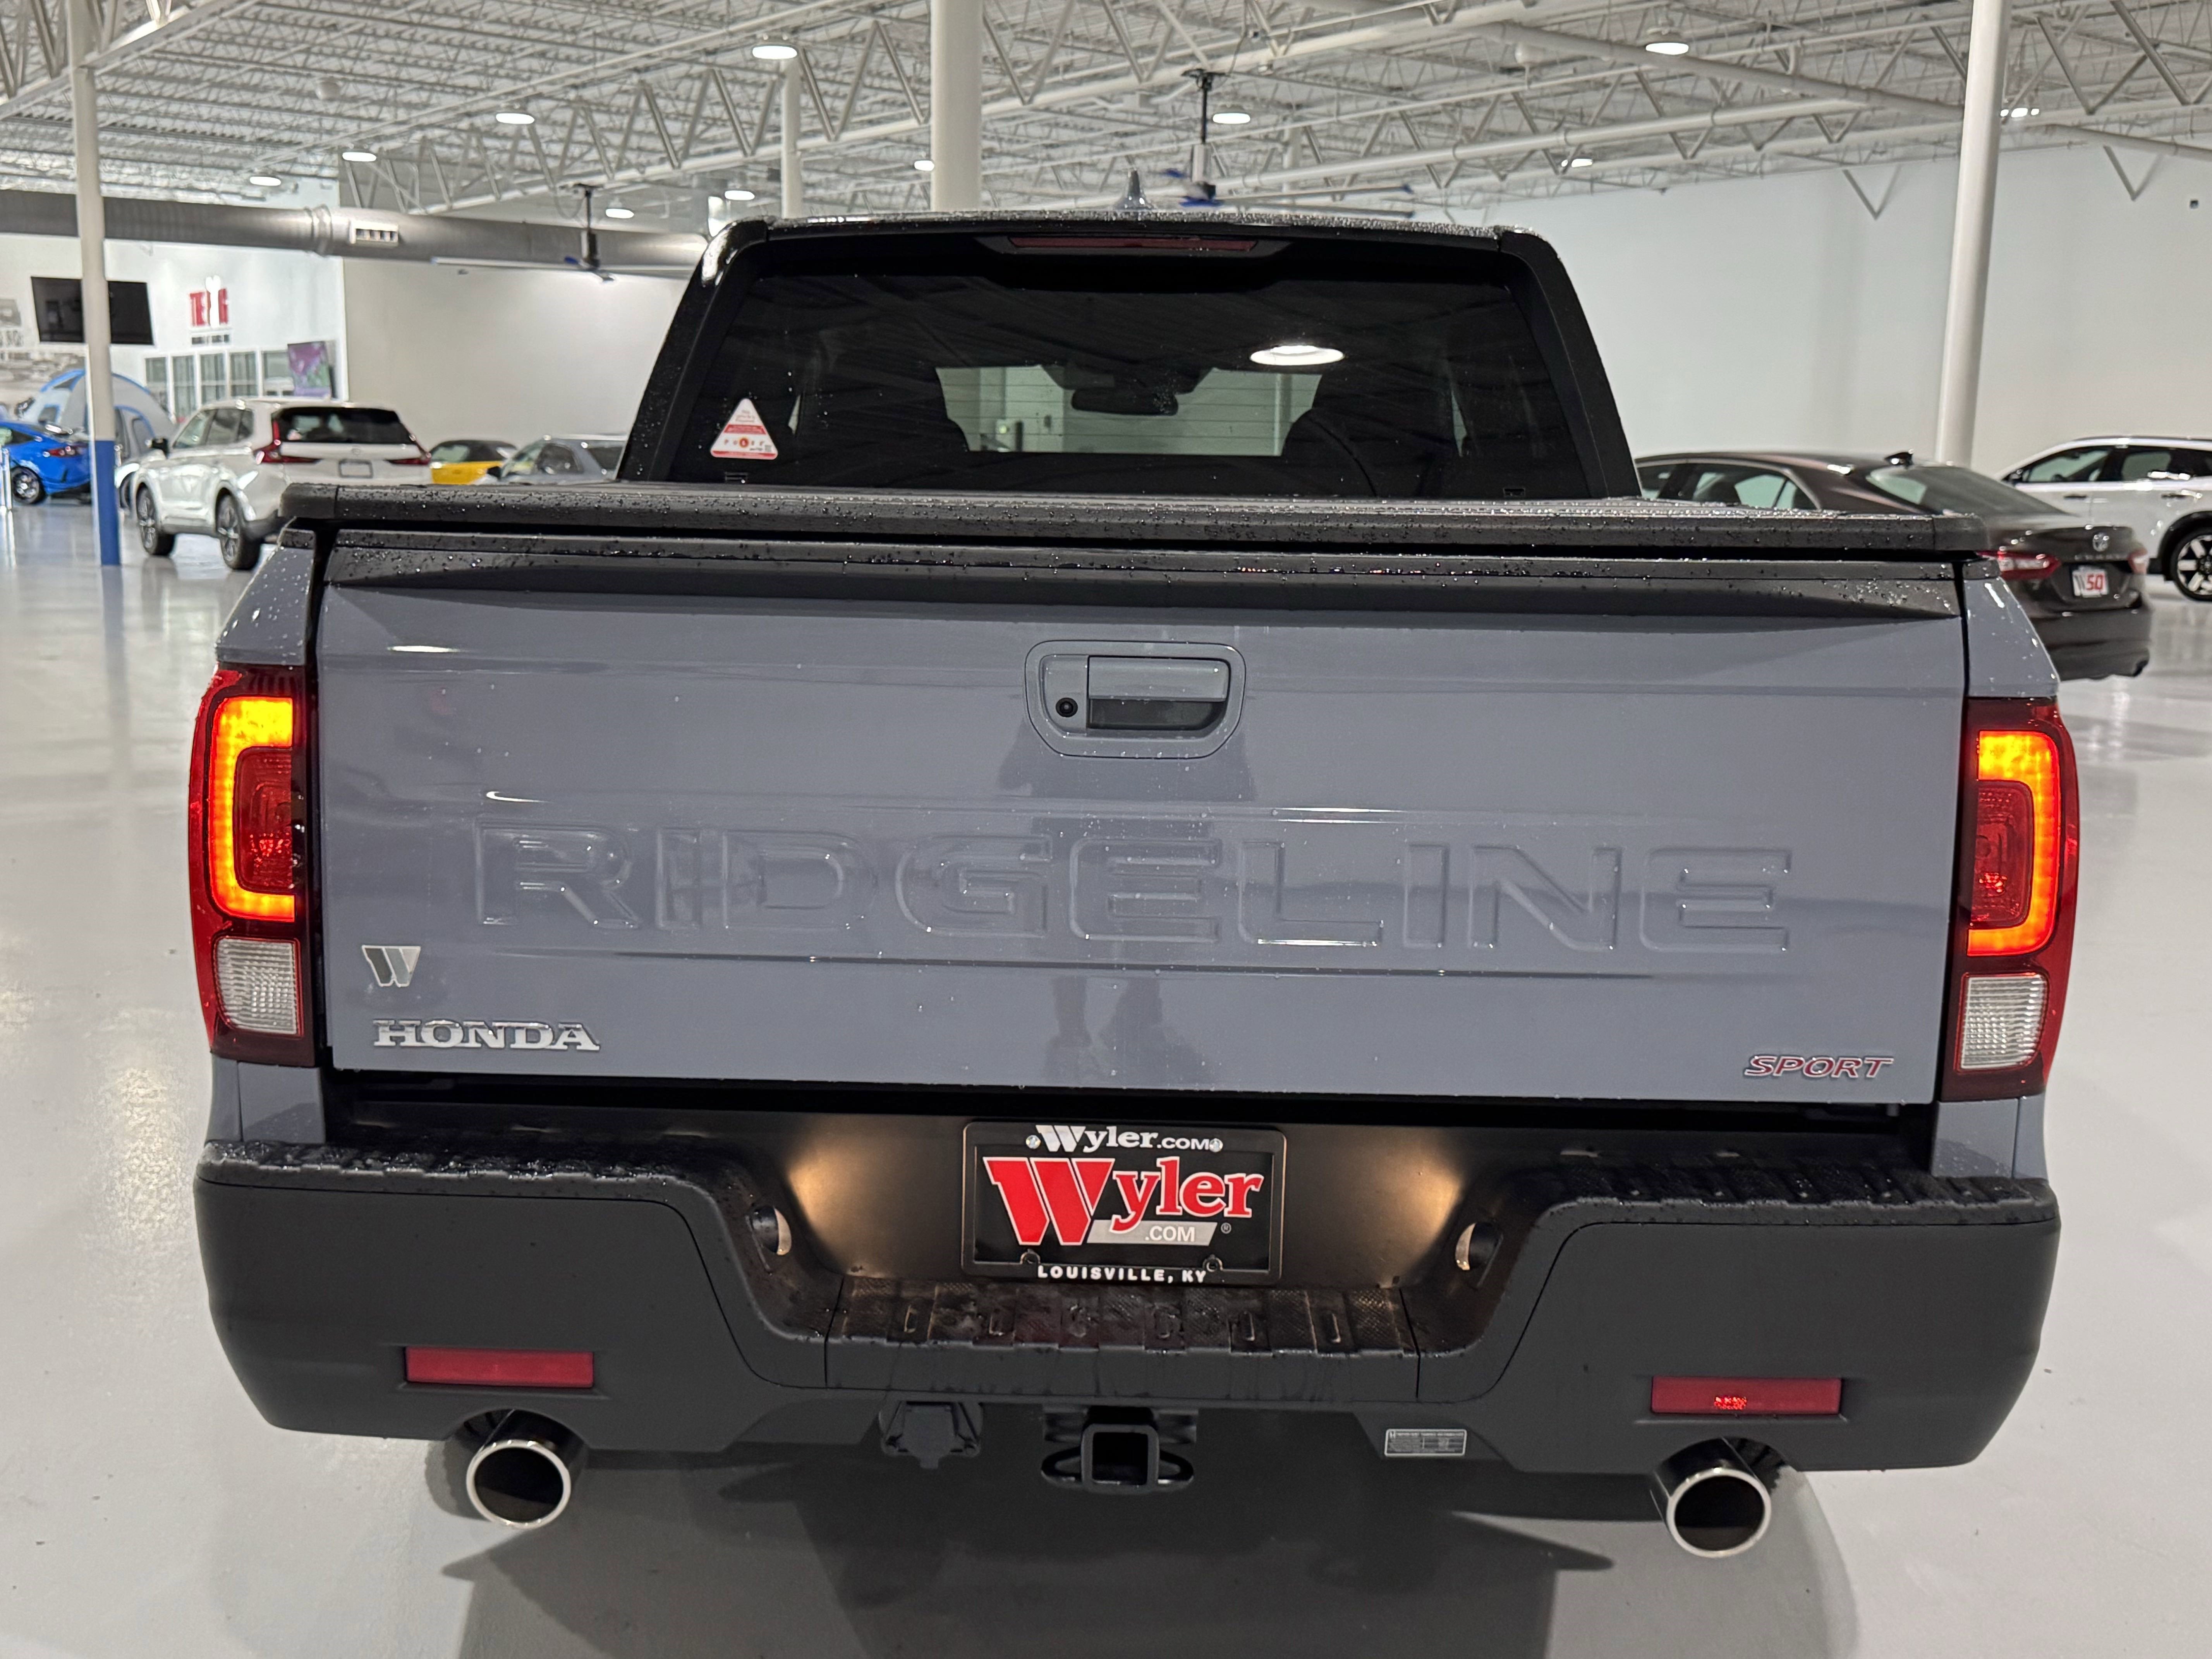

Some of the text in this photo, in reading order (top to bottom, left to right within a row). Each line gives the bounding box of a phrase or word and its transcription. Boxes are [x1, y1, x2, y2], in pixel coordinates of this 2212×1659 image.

[473, 820, 1793, 954] RIDGELINE
[373, 1020, 601, 1051] HONDA
[1744, 1055, 1894, 1078] SPORT
[983, 1156, 1264, 1245] Wyler
[1038, 1266, 1207, 1283] LOUISVILLE, KY
